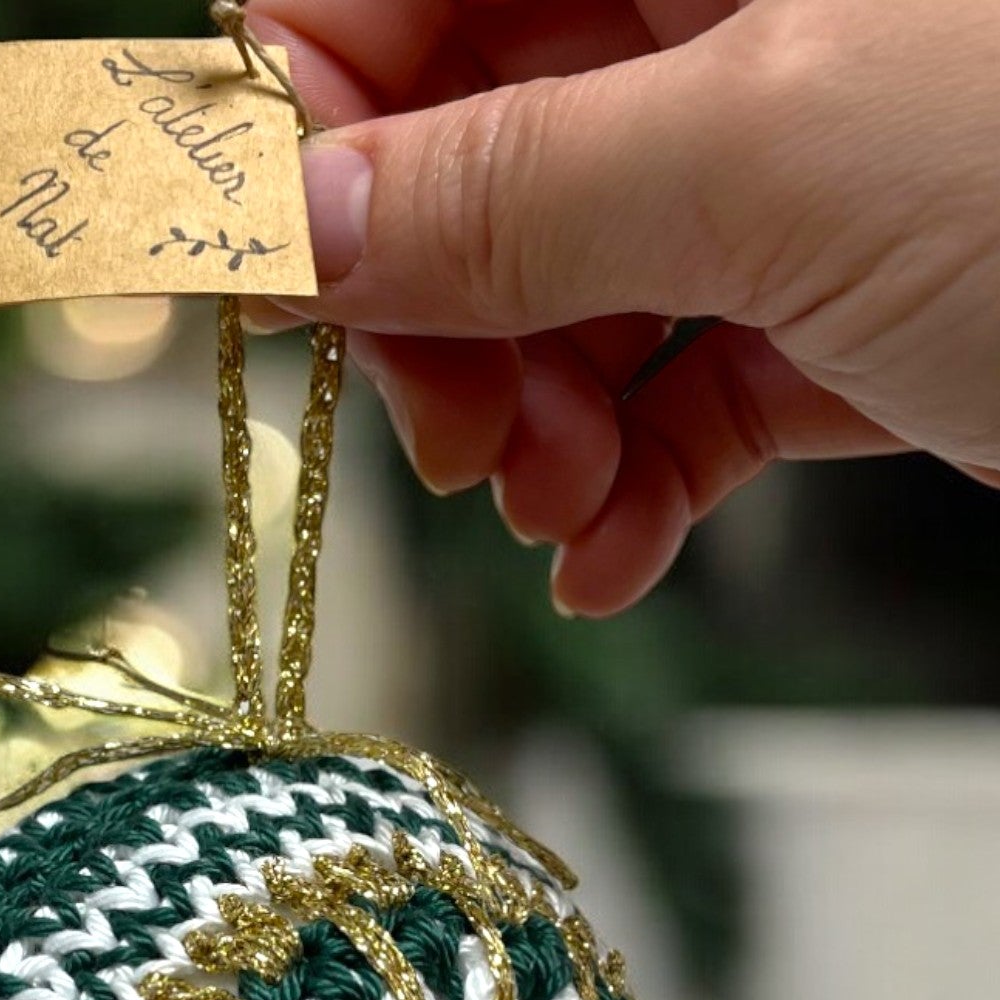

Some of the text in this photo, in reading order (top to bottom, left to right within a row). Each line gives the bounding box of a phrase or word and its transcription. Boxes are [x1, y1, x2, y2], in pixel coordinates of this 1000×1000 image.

[63, 119, 130, 172] de
[101, 48, 254, 206] L'atelier
[0, 168, 89, 258] Nat
